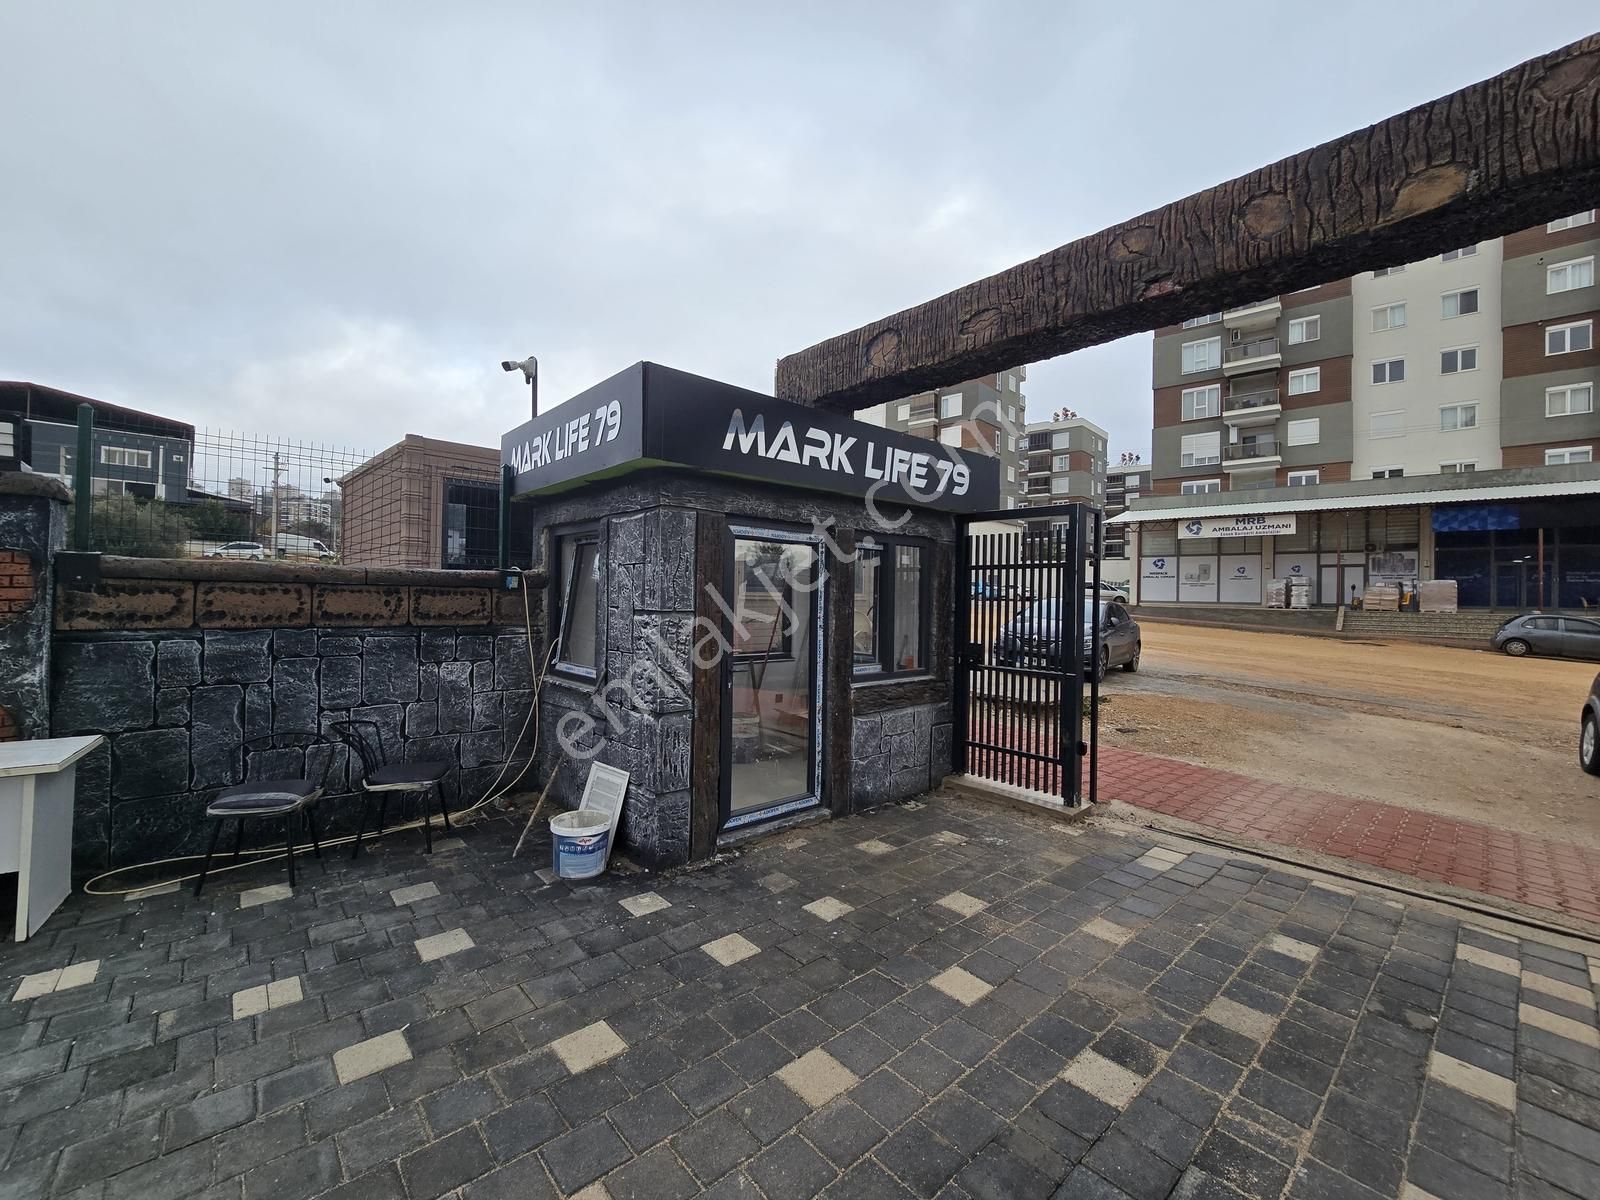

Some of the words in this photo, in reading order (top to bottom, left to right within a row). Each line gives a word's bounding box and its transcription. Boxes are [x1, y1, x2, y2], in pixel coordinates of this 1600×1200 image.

[511, 430, 553, 476] MARK
[555, 413, 591, 460] LIFE
[595, 400, 621, 446] 79
[722, 408, 858, 474] MARK
[864, 441, 930, 488] LIFE
[936, 460, 970, 496] 79
[1235, 517, 1266, 525] MRB
[1255, 523, 1291, 531] UZMANI
